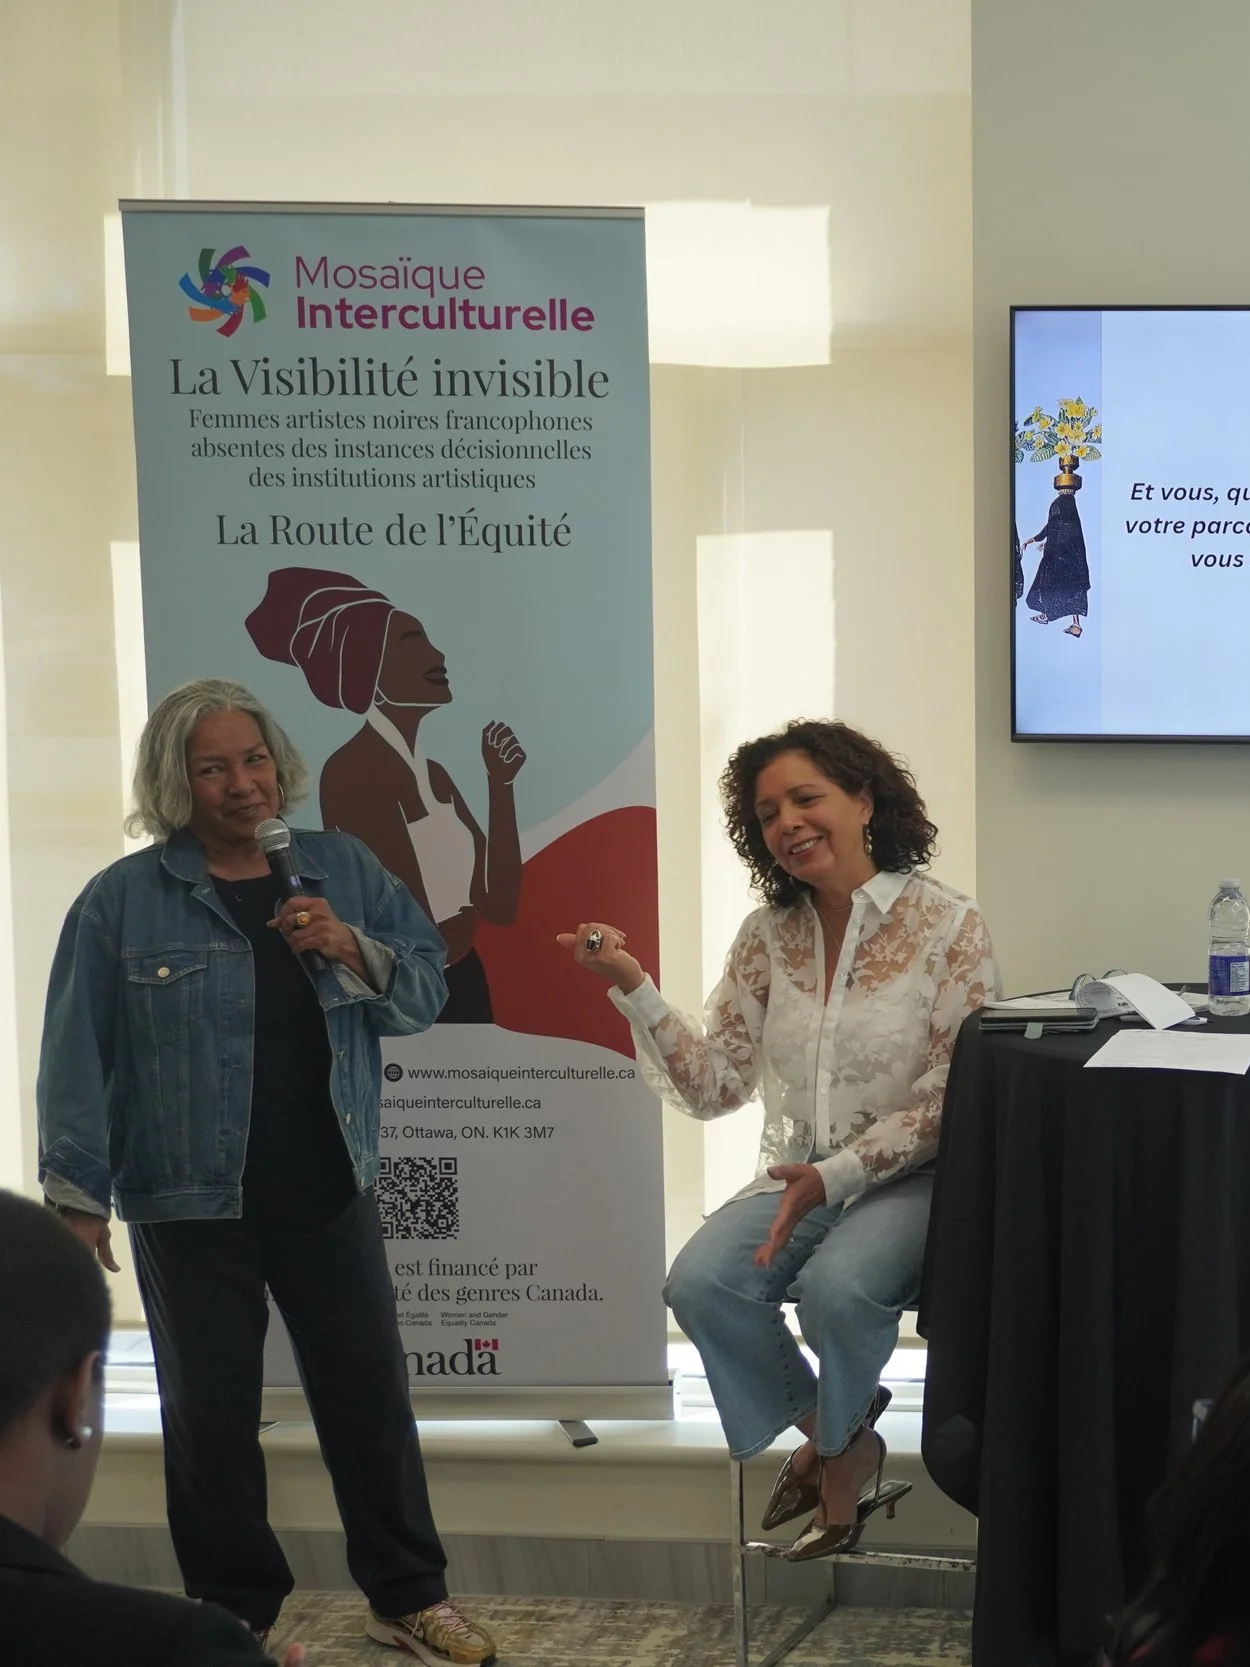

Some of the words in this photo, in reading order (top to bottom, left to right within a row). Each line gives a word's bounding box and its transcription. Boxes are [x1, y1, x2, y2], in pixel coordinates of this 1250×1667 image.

[295, 255, 486, 298] Mosaïque
[296, 296, 595, 332] Interculturelle
[169, 358, 222, 396] La
[229, 355, 419, 398] Visibilité
[431, 358, 610, 399] invisible
[188, 408, 280, 430] Femmes
[286, 408, 366, 431] artistes
[372, 409, 439, 431] noires
[446, 409, 593, 435] francophones
[191, 436, 285, 459] absentes
[291, 437, 328, 459] des
[334, 437, 435, 460] instances
[440, 437, 592, 461] décisionnelles
[248, 466, 286, 488] des
[292, 466, 416, 489] institutions
[422, 467, 536, 493] artistiques
[1130, 482, 1155, 501] Et
[1161, 487, 1220, 505] vous,
[215, 514, 260, 546] La
[269, 514, 374, 547] Route
[385, 512, 427, 547] de
[436, 506, 572, 554] l'Équité
[1125, 517, 1186, 535] votre
[1190, 553, 1244, 569] vous
[407, 1066, 636, 1083] www.mosaiqueinterculturelle.ca
[379, 1095, 542, 1111] saiqueinterculturelle.ca
[402, 1125, 458, 1141] Ottawa,
[461, 1126, 489, 1140] ON.
[493, 1126, 520, 1140] K1K
[524, 1126, 555, 1140] 3M7
[395, 1259, 424, 1277] est
[428, 1256, 500, 1277] financé
[505, 1262, 539, 1280] par
[417, 1283, 451, 1302] des
[455, 1286, 521, 1305] genres
[525, 1283, 604, 1302] Canada.
[441, 1320, 468, 1328] Equality
[404, 1338, 502, 1376] nada
